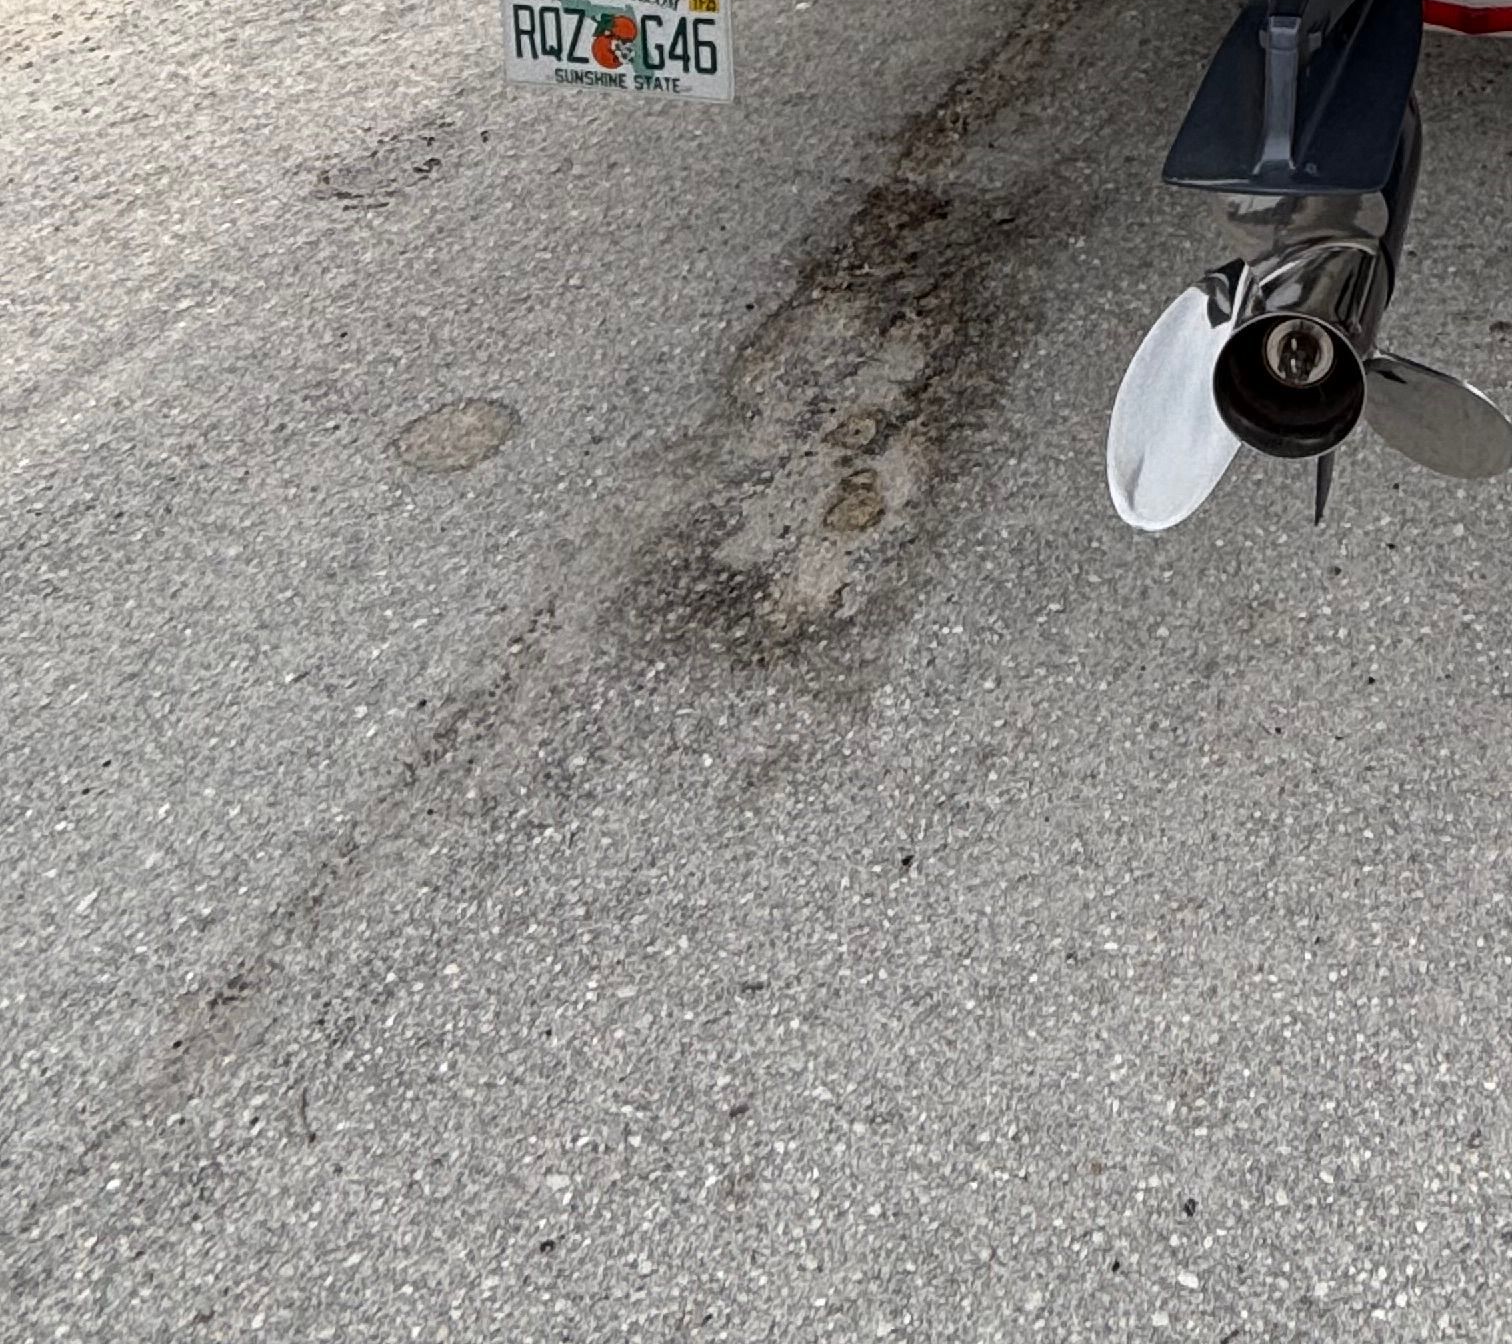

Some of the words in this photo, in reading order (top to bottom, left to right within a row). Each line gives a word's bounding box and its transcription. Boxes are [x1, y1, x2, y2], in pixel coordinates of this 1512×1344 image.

[512, 4, 590, 64] RQZ
[640, 14, 718, 75] G46
[554, 68, 628, 90] SUNSHINE
[634, 75, 681, 95] STATE
